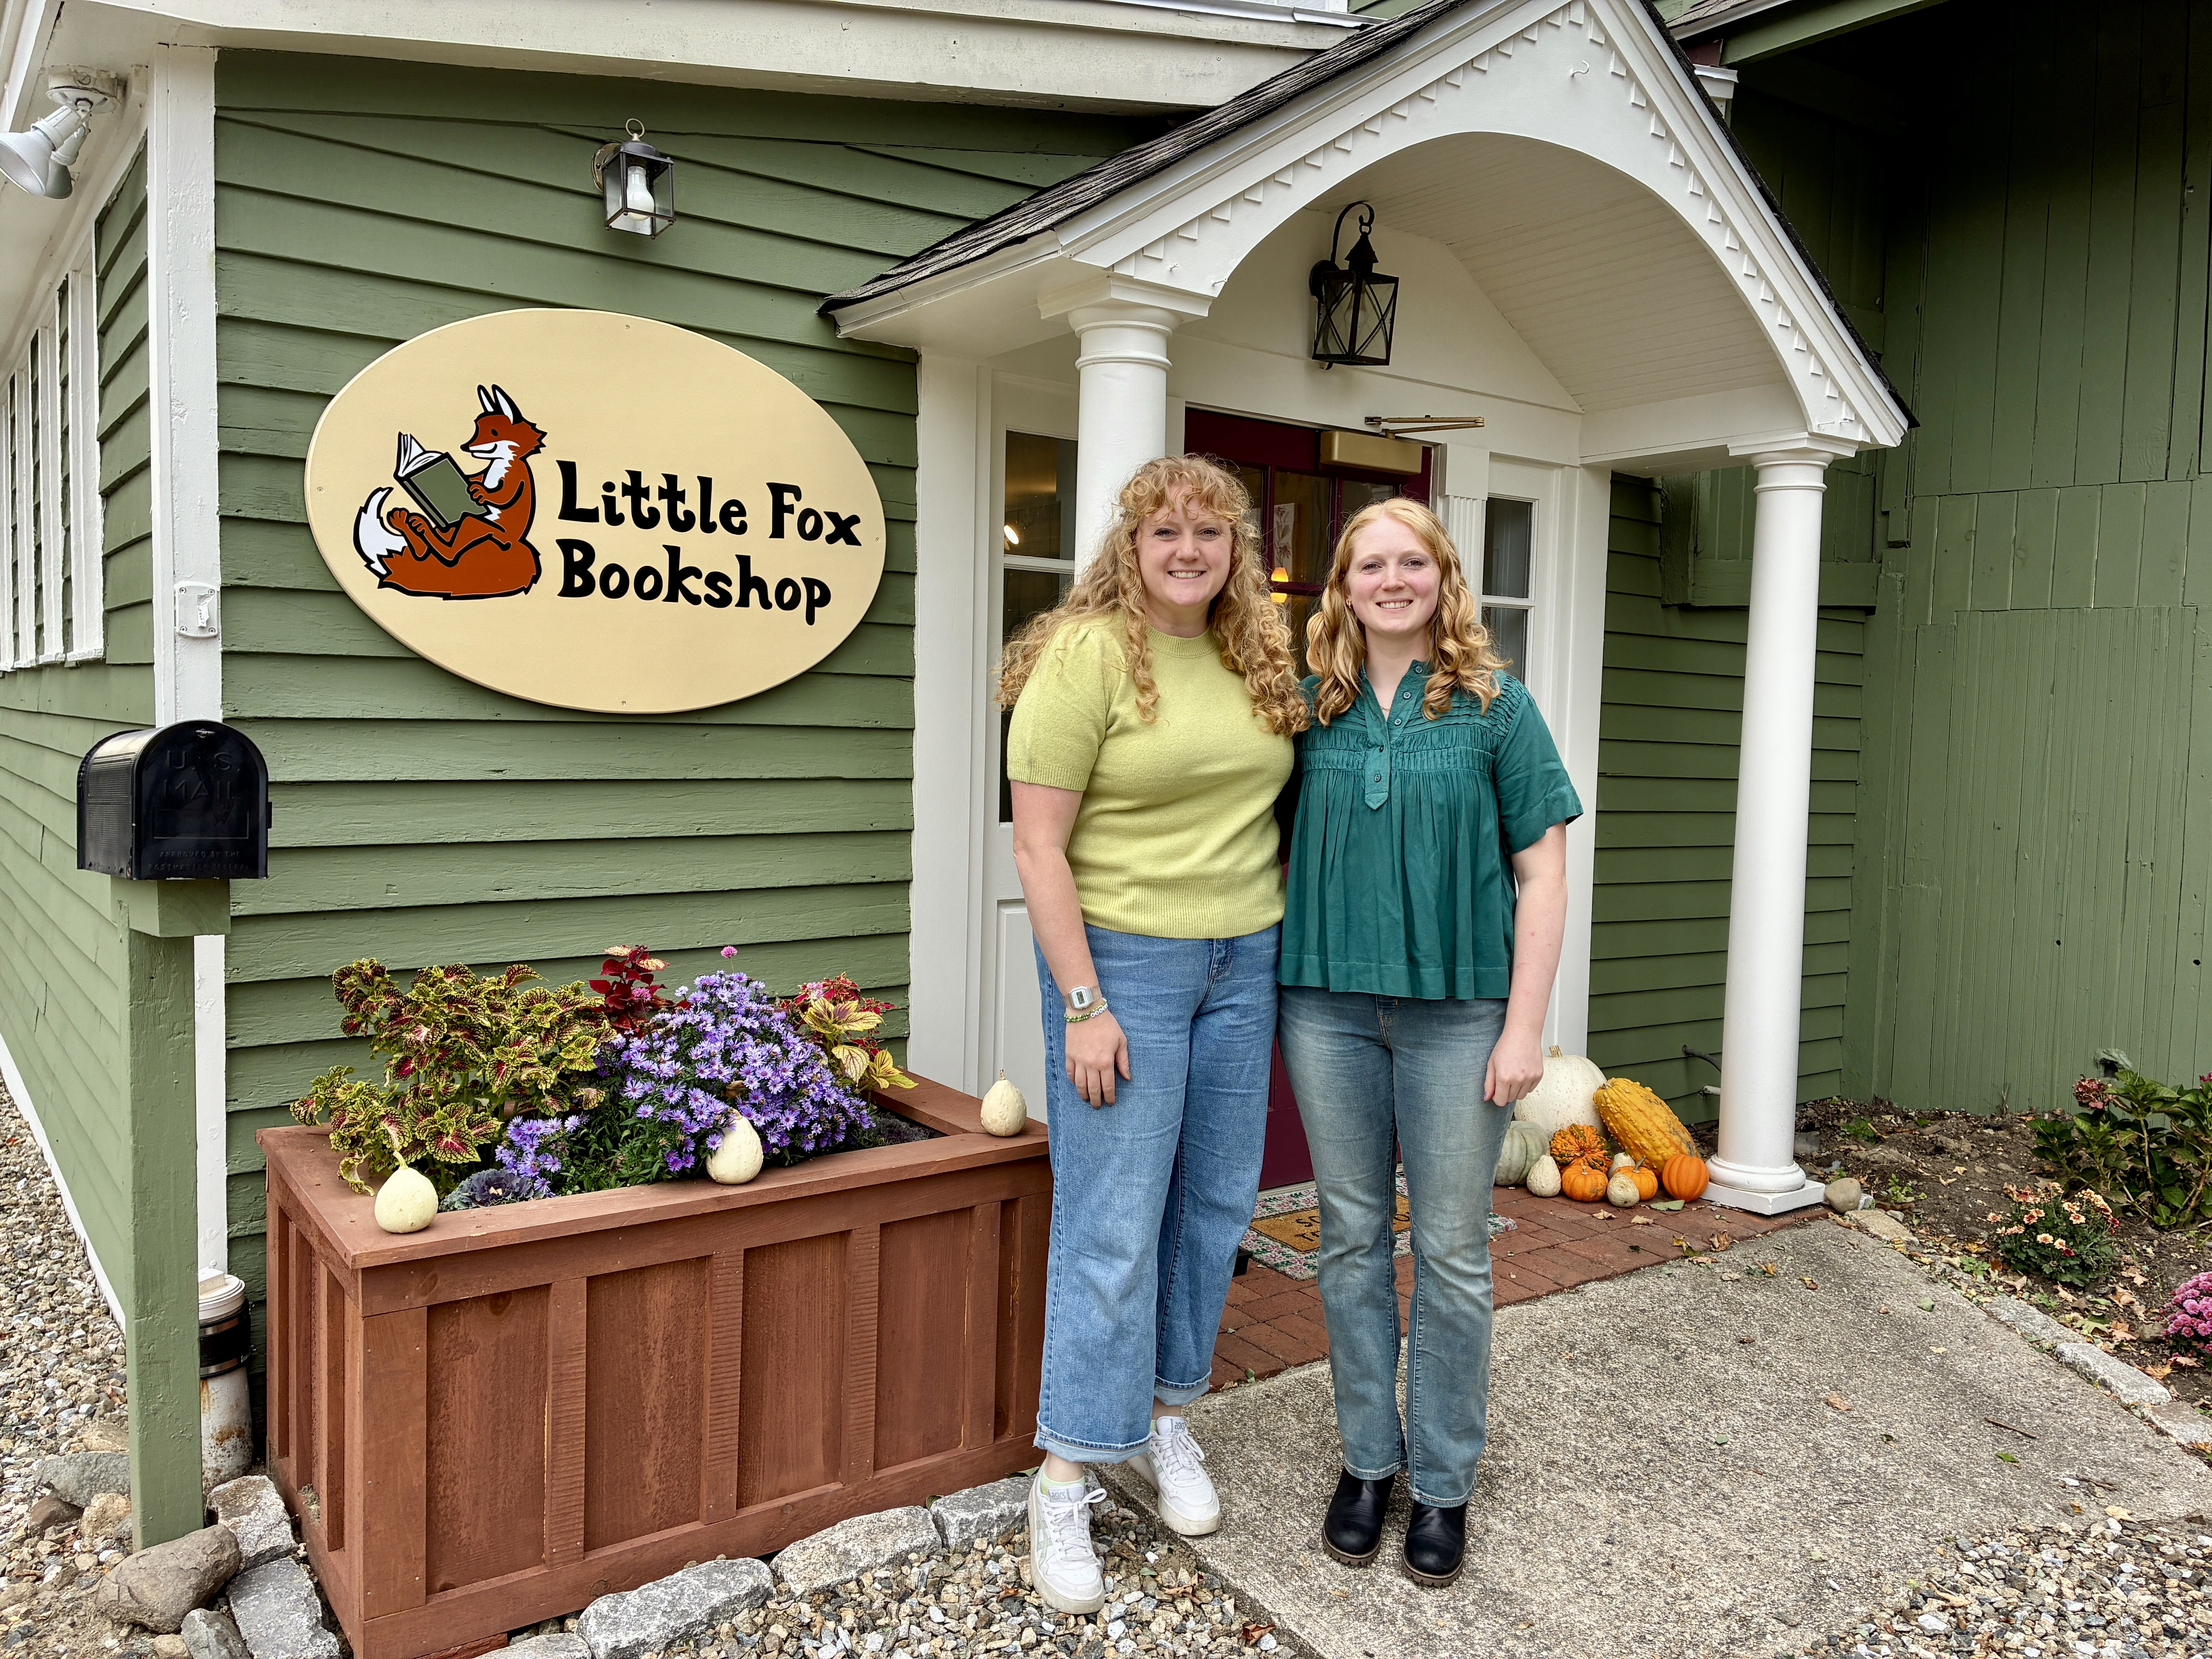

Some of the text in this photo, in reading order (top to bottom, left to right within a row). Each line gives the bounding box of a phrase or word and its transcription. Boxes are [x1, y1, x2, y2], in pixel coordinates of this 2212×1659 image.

[556, 460, 862, 546] Little Fox
[555, 539, 831, 626] Bookshop
[1051, 1492, 1066, 1500] asics
